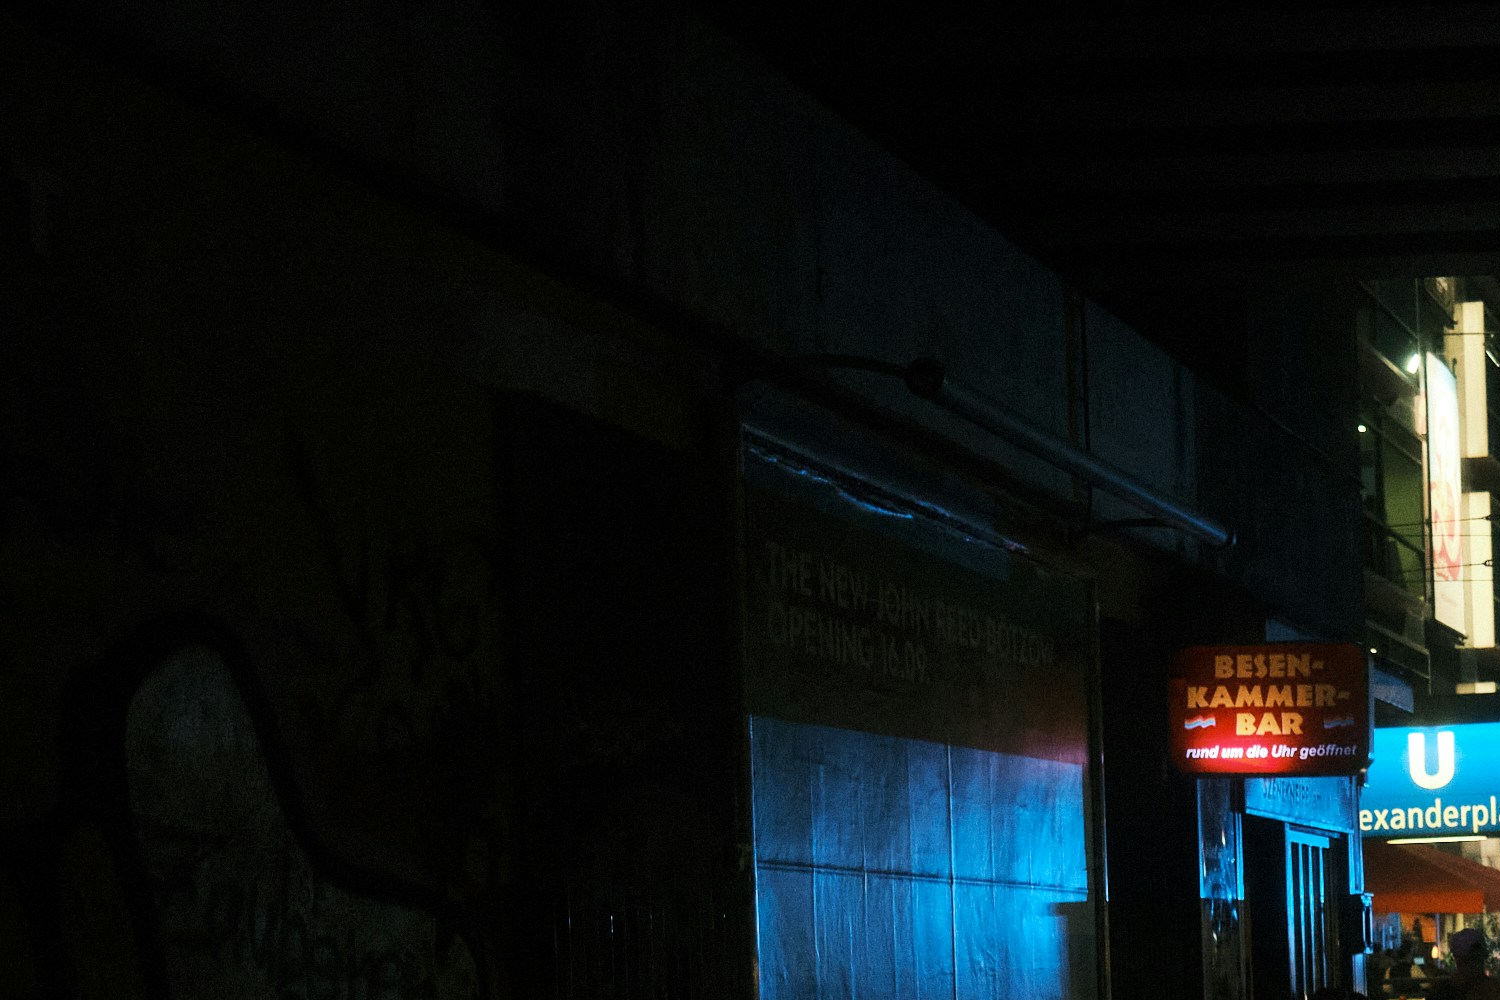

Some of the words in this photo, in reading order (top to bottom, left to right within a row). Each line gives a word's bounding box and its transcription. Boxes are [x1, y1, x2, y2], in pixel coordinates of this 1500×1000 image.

[765, 541, 812, 597] THE
[819, 559, 869, 611] NEW
[876, 580, 930, 635] JOHN
[936, 600, 981, 649] REED
[767, 602, 875, 669] OPENING
[1214, 653, 1325, 679] BESEN-
[1186, 683, 1351, 709] KAMMER-
[1235, 712, 1304, 736] BAR
[1186, 745, 1219, 759] rund
[1221, 747, 1243, 759] um
[1246, 744, 1268, 759] die
[1271, 744, 1297, 758] Uhr
[1299, 743, 1358, 760] geöffnet
[1408, 731, 1455, 790] U
